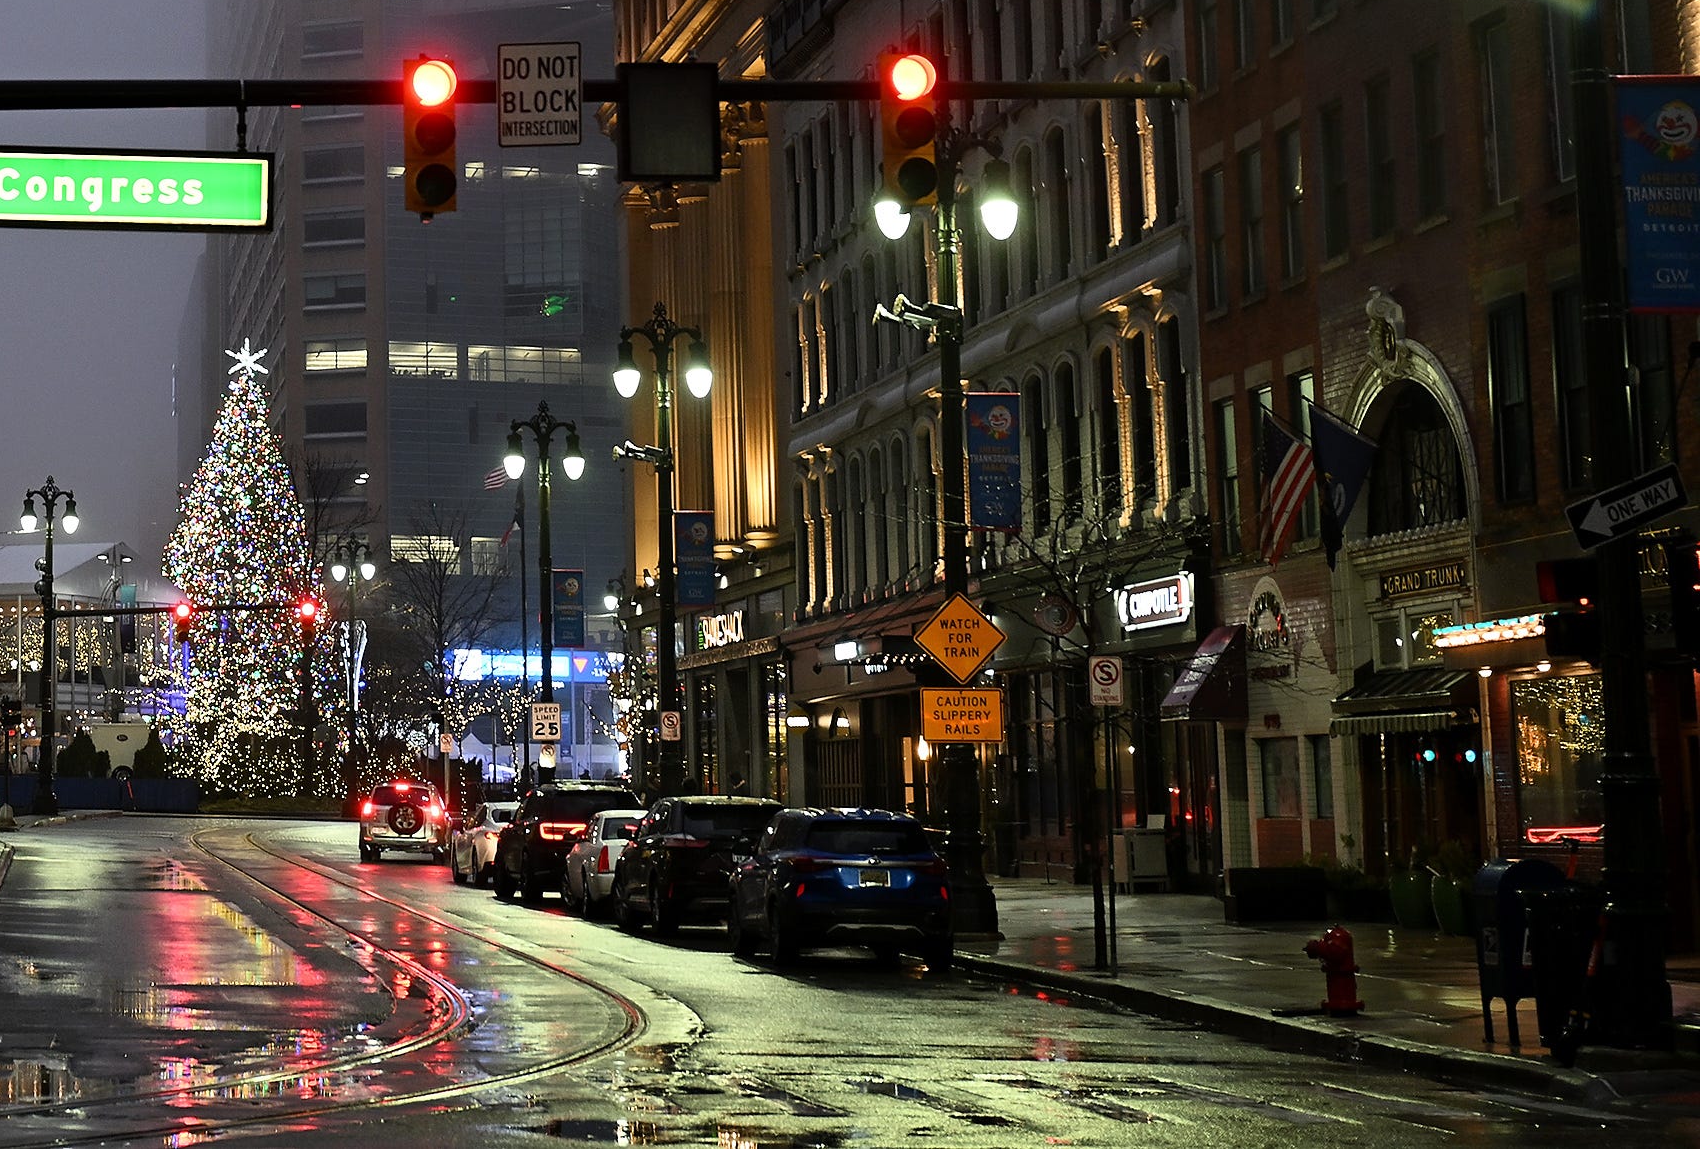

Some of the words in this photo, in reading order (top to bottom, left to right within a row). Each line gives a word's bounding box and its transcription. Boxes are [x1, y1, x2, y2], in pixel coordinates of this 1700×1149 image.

[502, 57, 530, 80] DO
[537, 56, 577, 79] NOT
[502, 89, 578, 114] BLOCK
[502, 119, 578, 137] INTERSECTION
[1607, 496, 1641, 522] ONE
[1640, 481, 1671, 508] WAY
[1388, 573, 1420, 593] GRAND
[1425, 565, 1460, 587] TRUNK
[940, 619, 980, 630] WATCH
[948, 633, 972, 643] FOR
[944, 647, 980, 657] TRAIN
[936, 696, 988, 707] CAUTION
[933, 710, 992, 721] SLIPPERY
[535, 722, 559, 736] 25
[945, 724, 981, 735] RAILS
